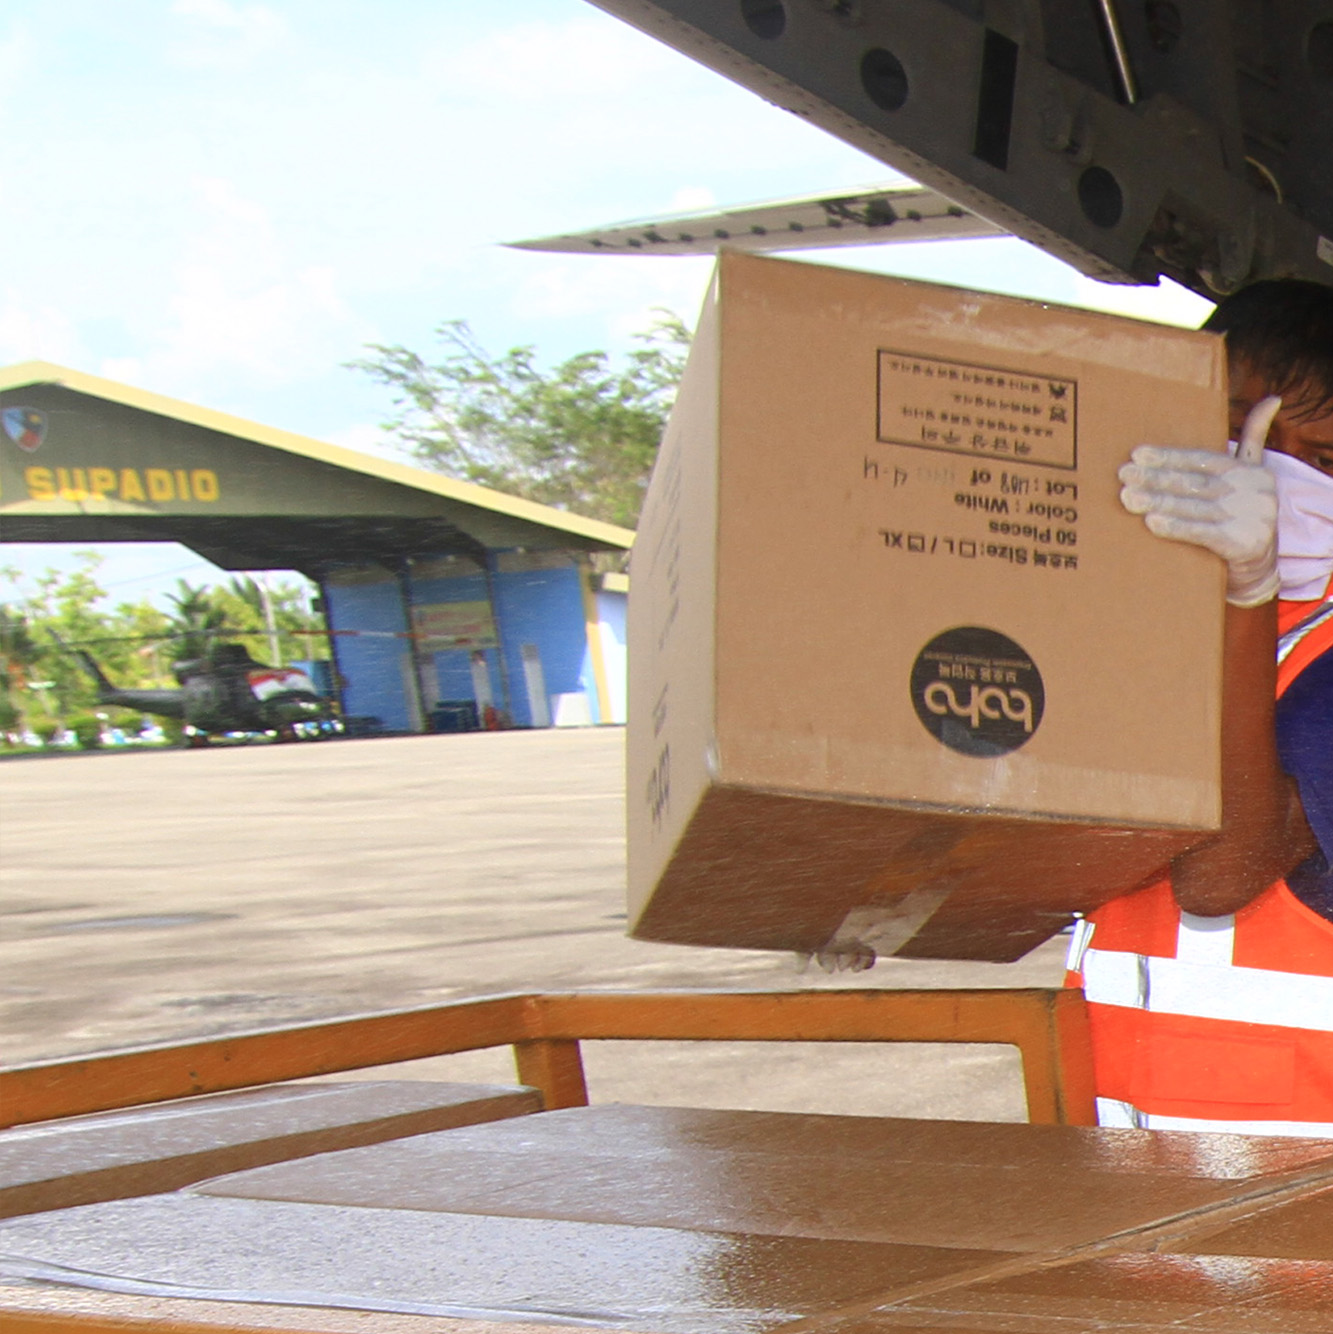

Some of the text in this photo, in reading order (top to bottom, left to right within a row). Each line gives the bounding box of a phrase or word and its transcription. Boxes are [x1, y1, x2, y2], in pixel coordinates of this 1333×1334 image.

[25, 467, 219, 501] SUPADIO
[970, 470, 991, 485] of
[1046, 481, 1077, 500] Lot
[954, 494, 1009, 515] White
[1028, 503, 1077, 524] Color
[879, 531, 903, 548] XL
[989, 521, 1077, 546] 50 Pieces
[981, 543, 1027, 564] Size:
[924, 682, 1033, 733] boho
